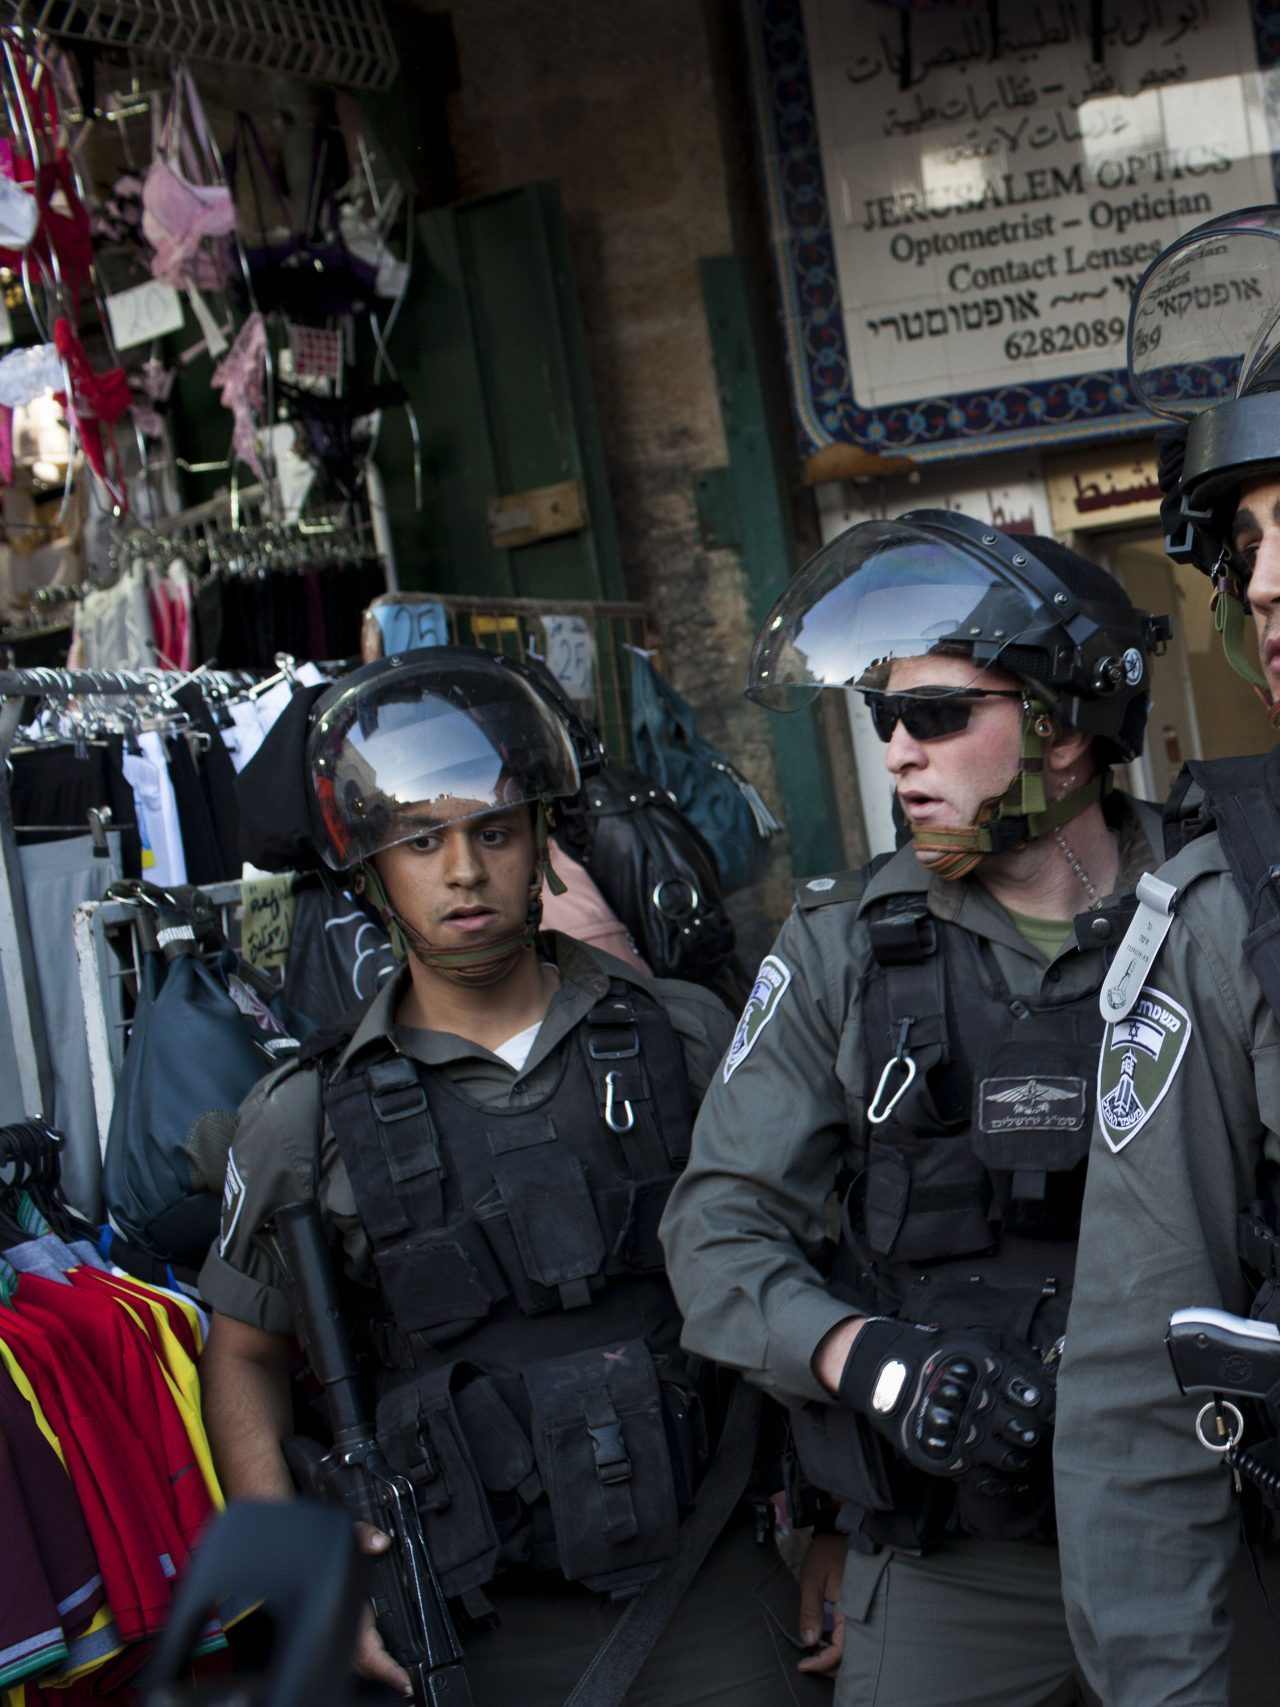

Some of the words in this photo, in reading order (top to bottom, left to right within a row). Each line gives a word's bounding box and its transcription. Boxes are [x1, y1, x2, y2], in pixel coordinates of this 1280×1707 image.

[863, 163, 1085, 231] JERUSALEM
[1096, 141, 1234, 191] OPTICS
[891, 212, 1055, 264] Optometrist
[1089, 190, 1212, 233] Optician
[947, 255, 1058, 294] Contact
[1065, 238, 1162, 277] Lenses
[1004, 316, 1125, 361] 6282089
